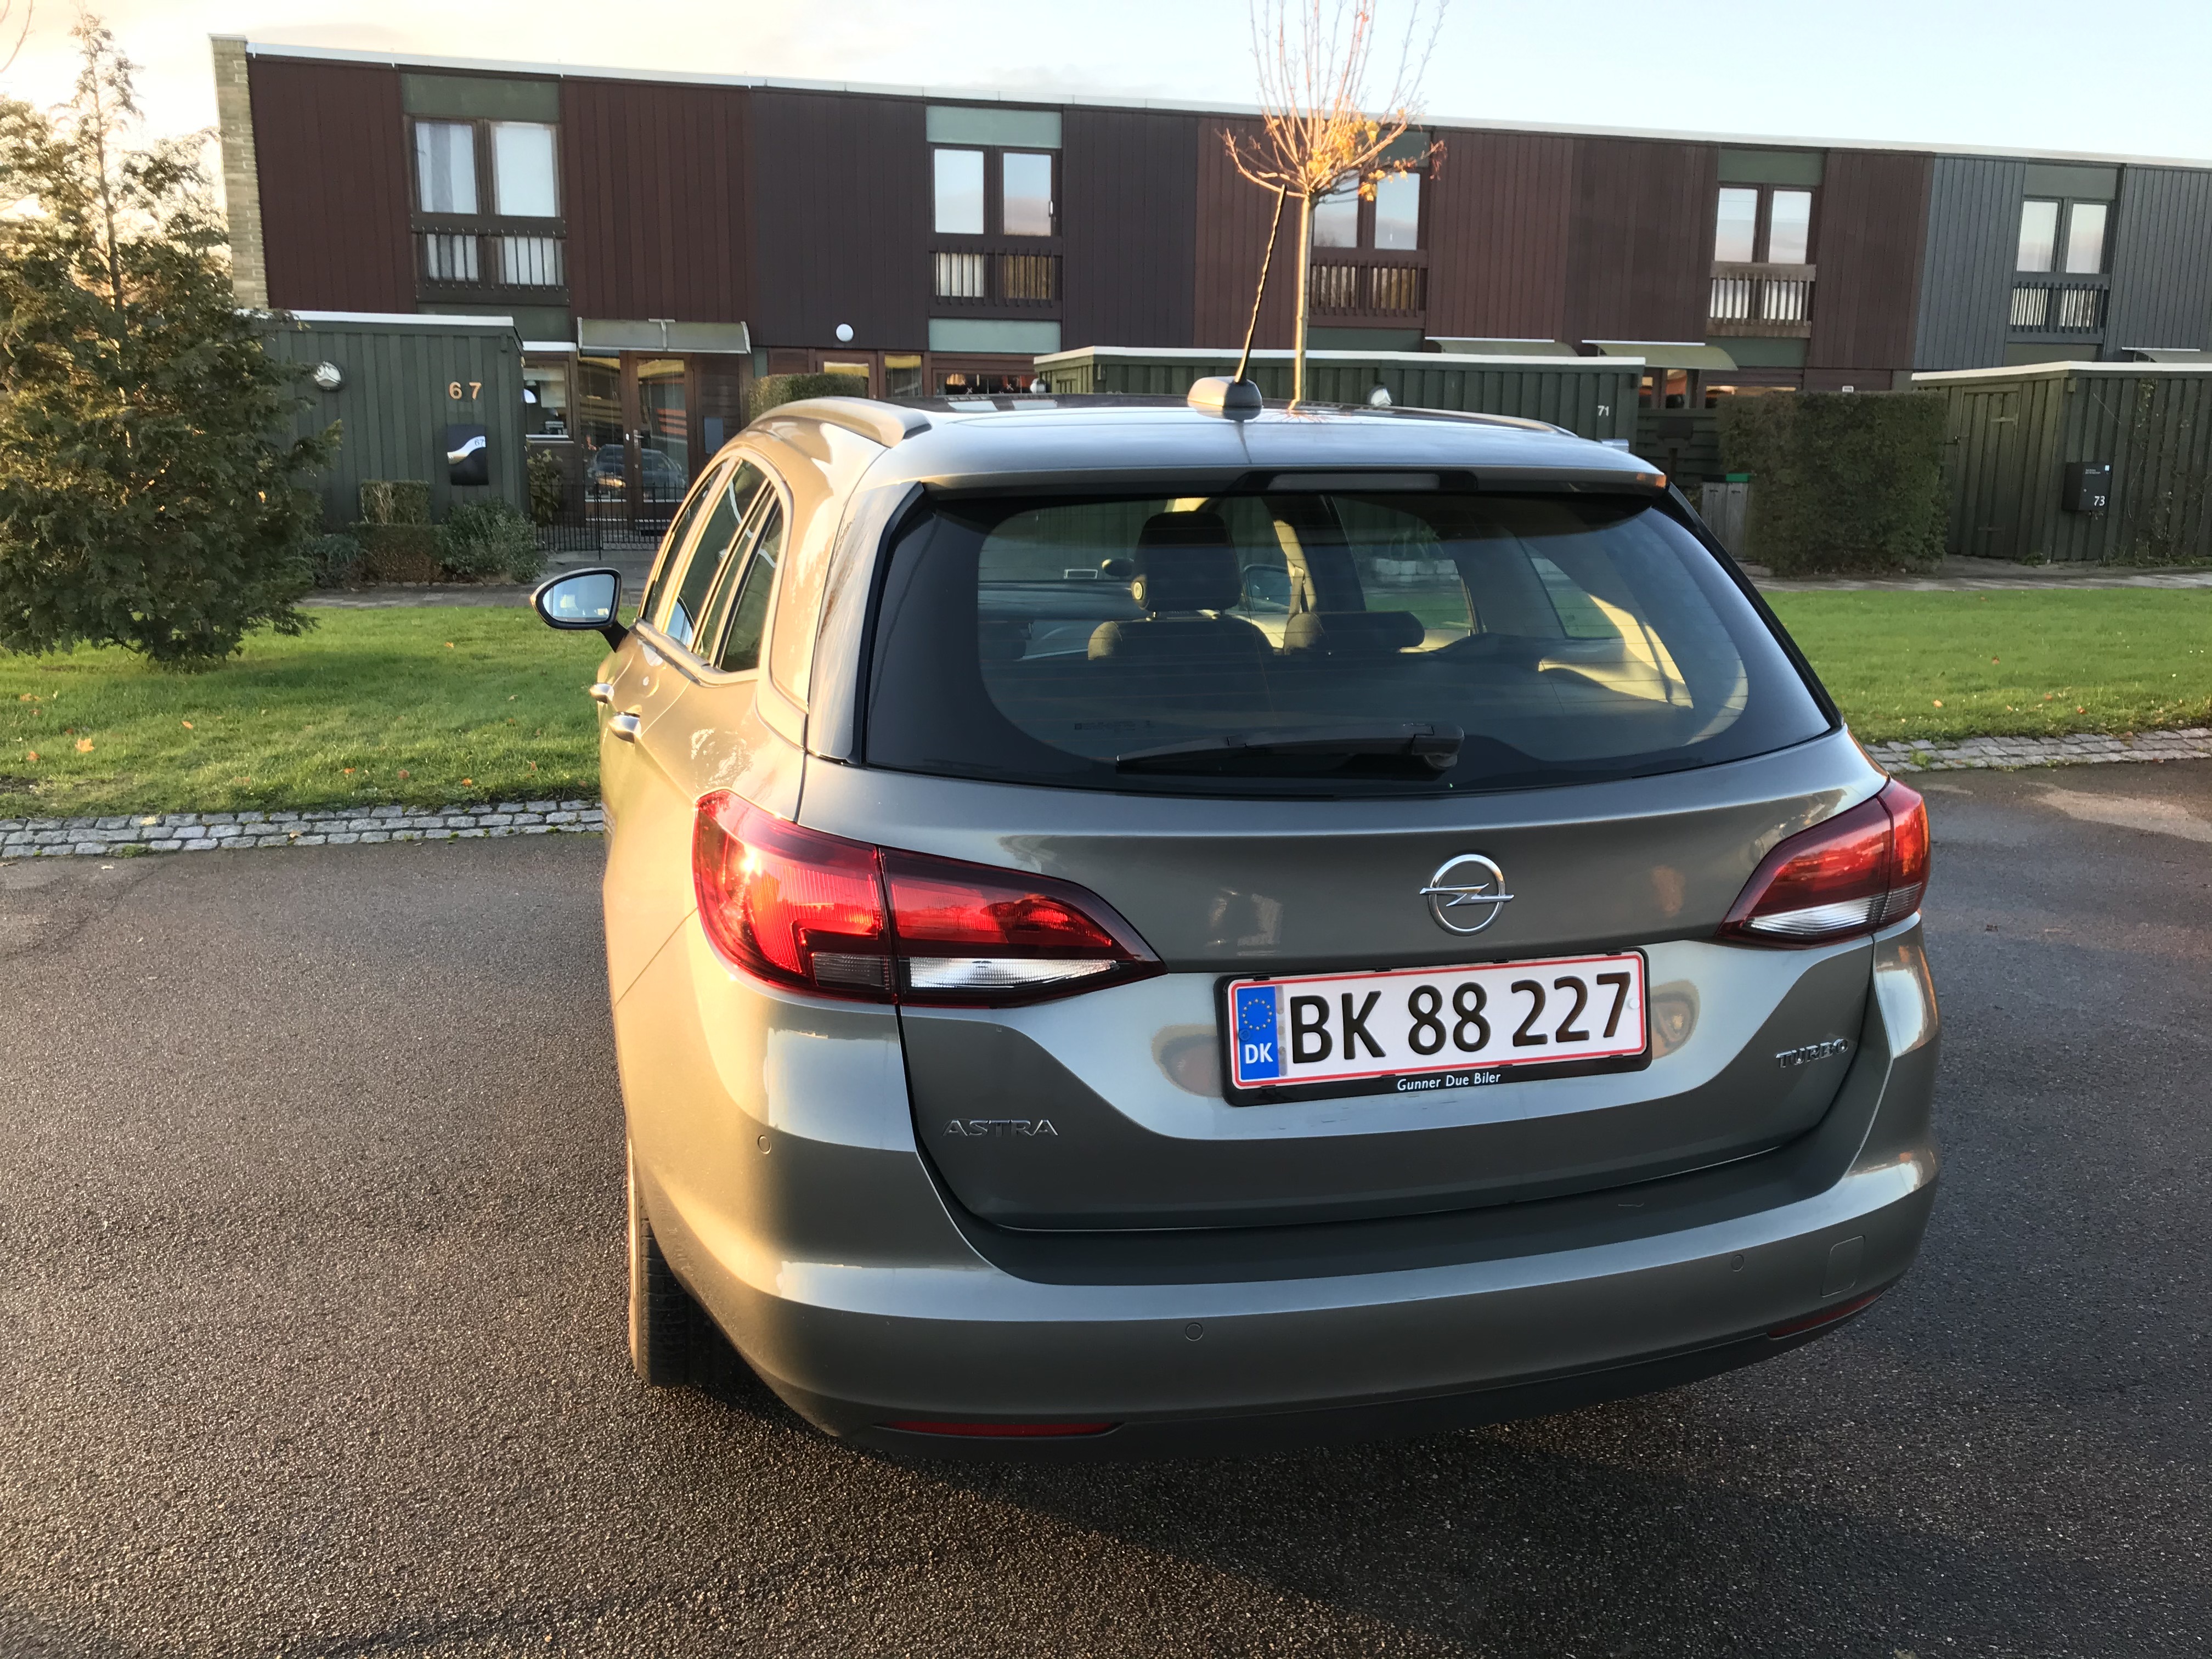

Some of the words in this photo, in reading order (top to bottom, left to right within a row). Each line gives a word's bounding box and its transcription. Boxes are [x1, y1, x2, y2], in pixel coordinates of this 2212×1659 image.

[449, 381, 482, 400] 67
[1598, 405, 1609, 416] 71
[2094, 495, 2106, 506] 73
[1290, 990, 1387, 1064] BK
[1407, 981, 1491, 1056] 88
[1511, 971, 1632, 1047] 227
[1245, 1042, 1274, 1064] DK
[1775, 1038, 1848, 1068] TURBO
[1397, 1078, 1442, 1091] Gunner
[1445, 1074, 1470, 1087] Due
[1474, 1071, 1502, 1085] Biler
[942, 1119, 1059, 1137] ASTRA
